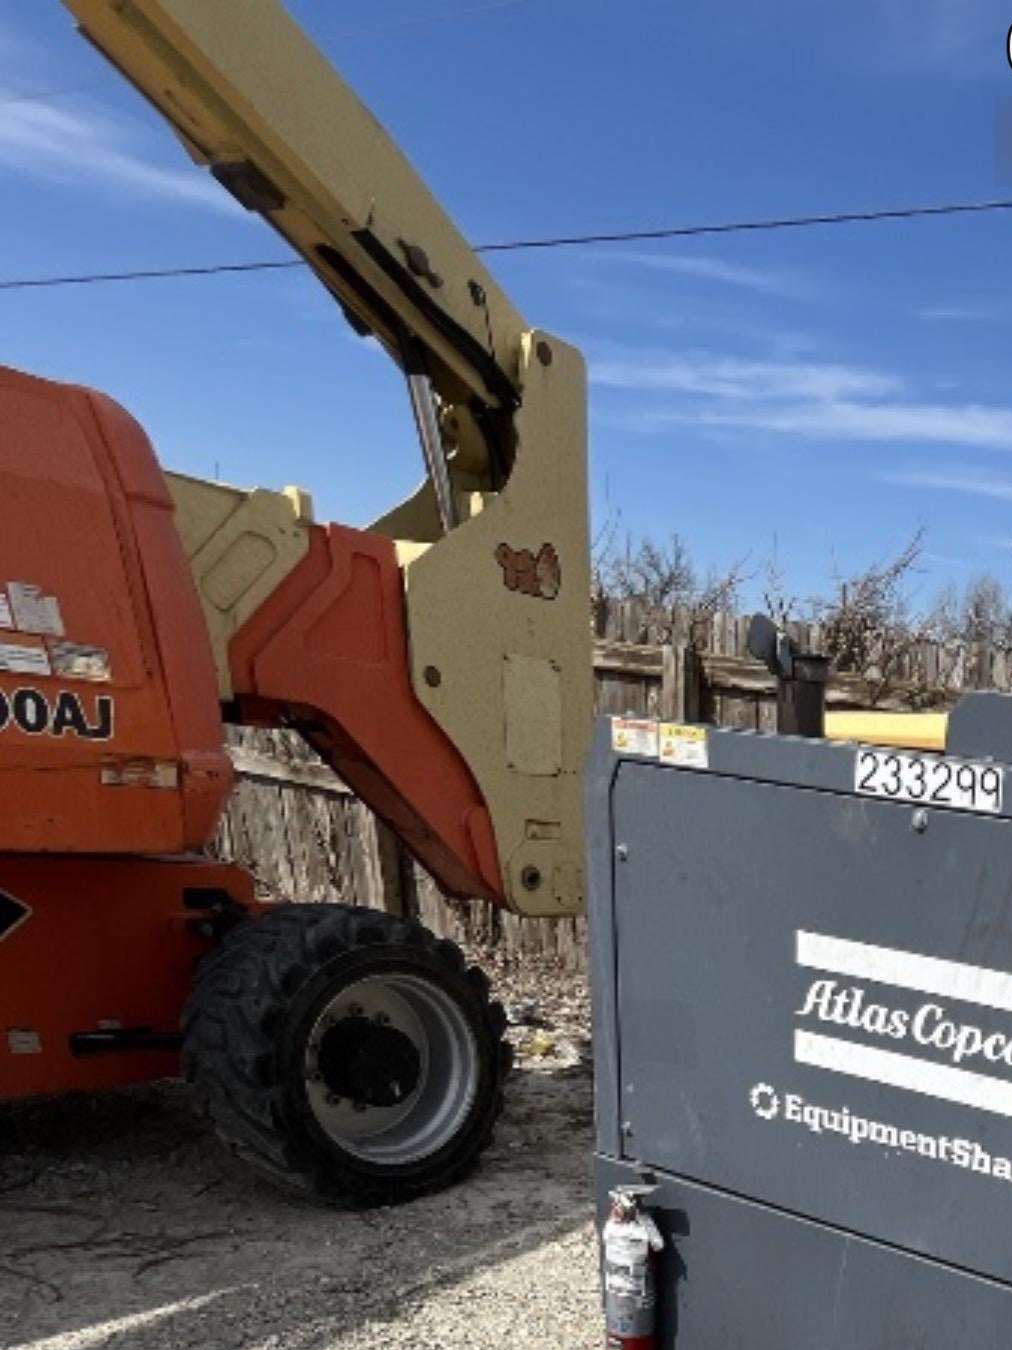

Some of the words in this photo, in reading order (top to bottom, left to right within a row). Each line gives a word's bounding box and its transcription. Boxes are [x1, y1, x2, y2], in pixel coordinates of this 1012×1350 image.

[0, 686, 115, 742] 0AJ
[857, 752, 1001, 809] 233299
[794, 979, 910, 1039] Atlas
